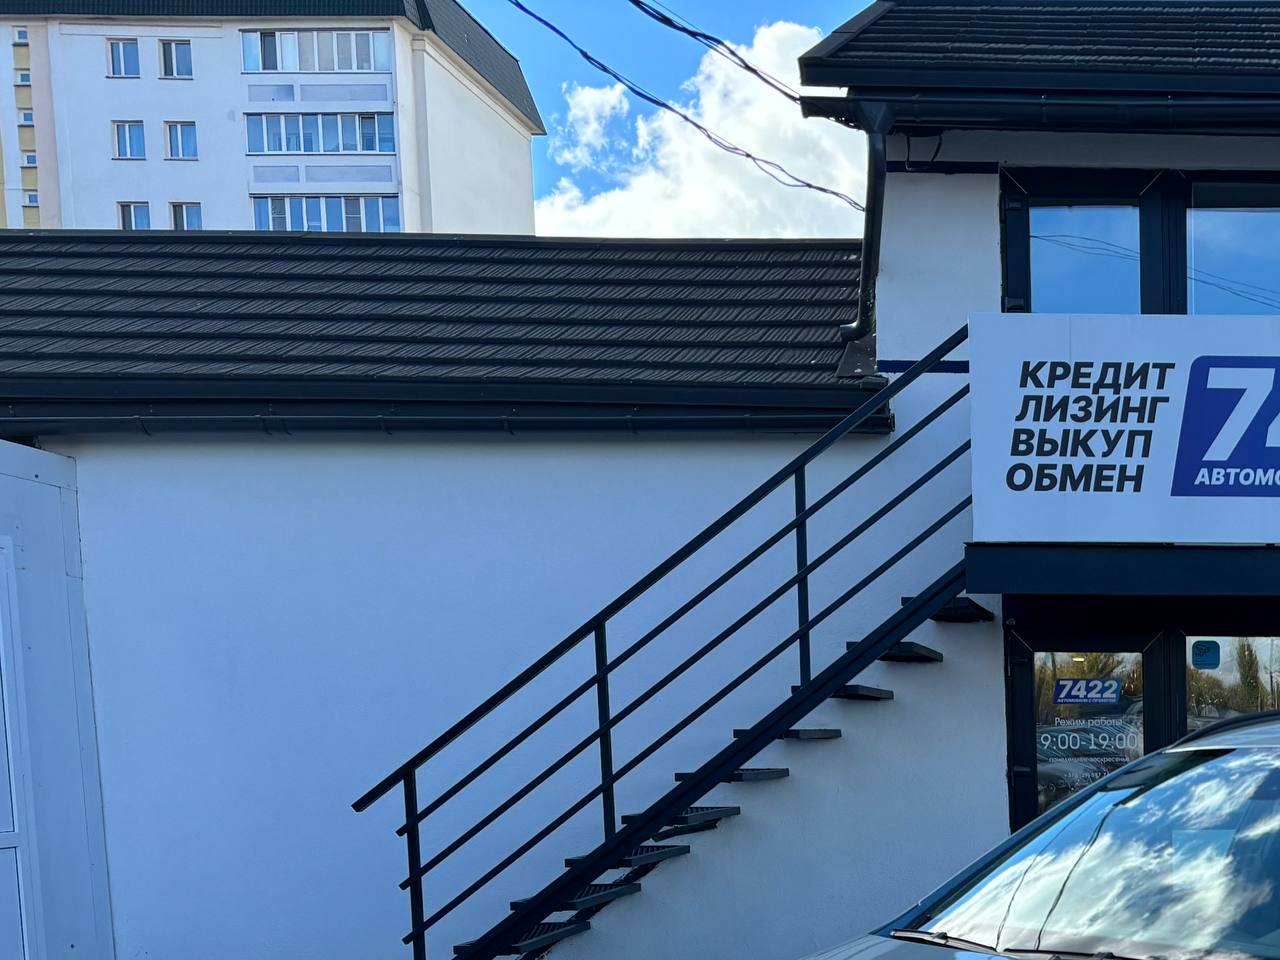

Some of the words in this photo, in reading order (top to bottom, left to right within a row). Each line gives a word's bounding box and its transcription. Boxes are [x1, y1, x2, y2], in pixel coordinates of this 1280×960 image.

[1019, 361, 1176, 395] КРЕДИТ
[1015, 395, 1170, 423] ЛИЗИНГ
[1010, 428, 1153, 458] ВЫКУП
[1006, 463, 1145, 492] ОБМЕН
[1058, 680, 1118, 698] 7422
[1055, 717, 1085, 726] Режим
[1087, 717, 1123, 728] работы
[1040, 733, 1138, 750] 9:00-19:00
